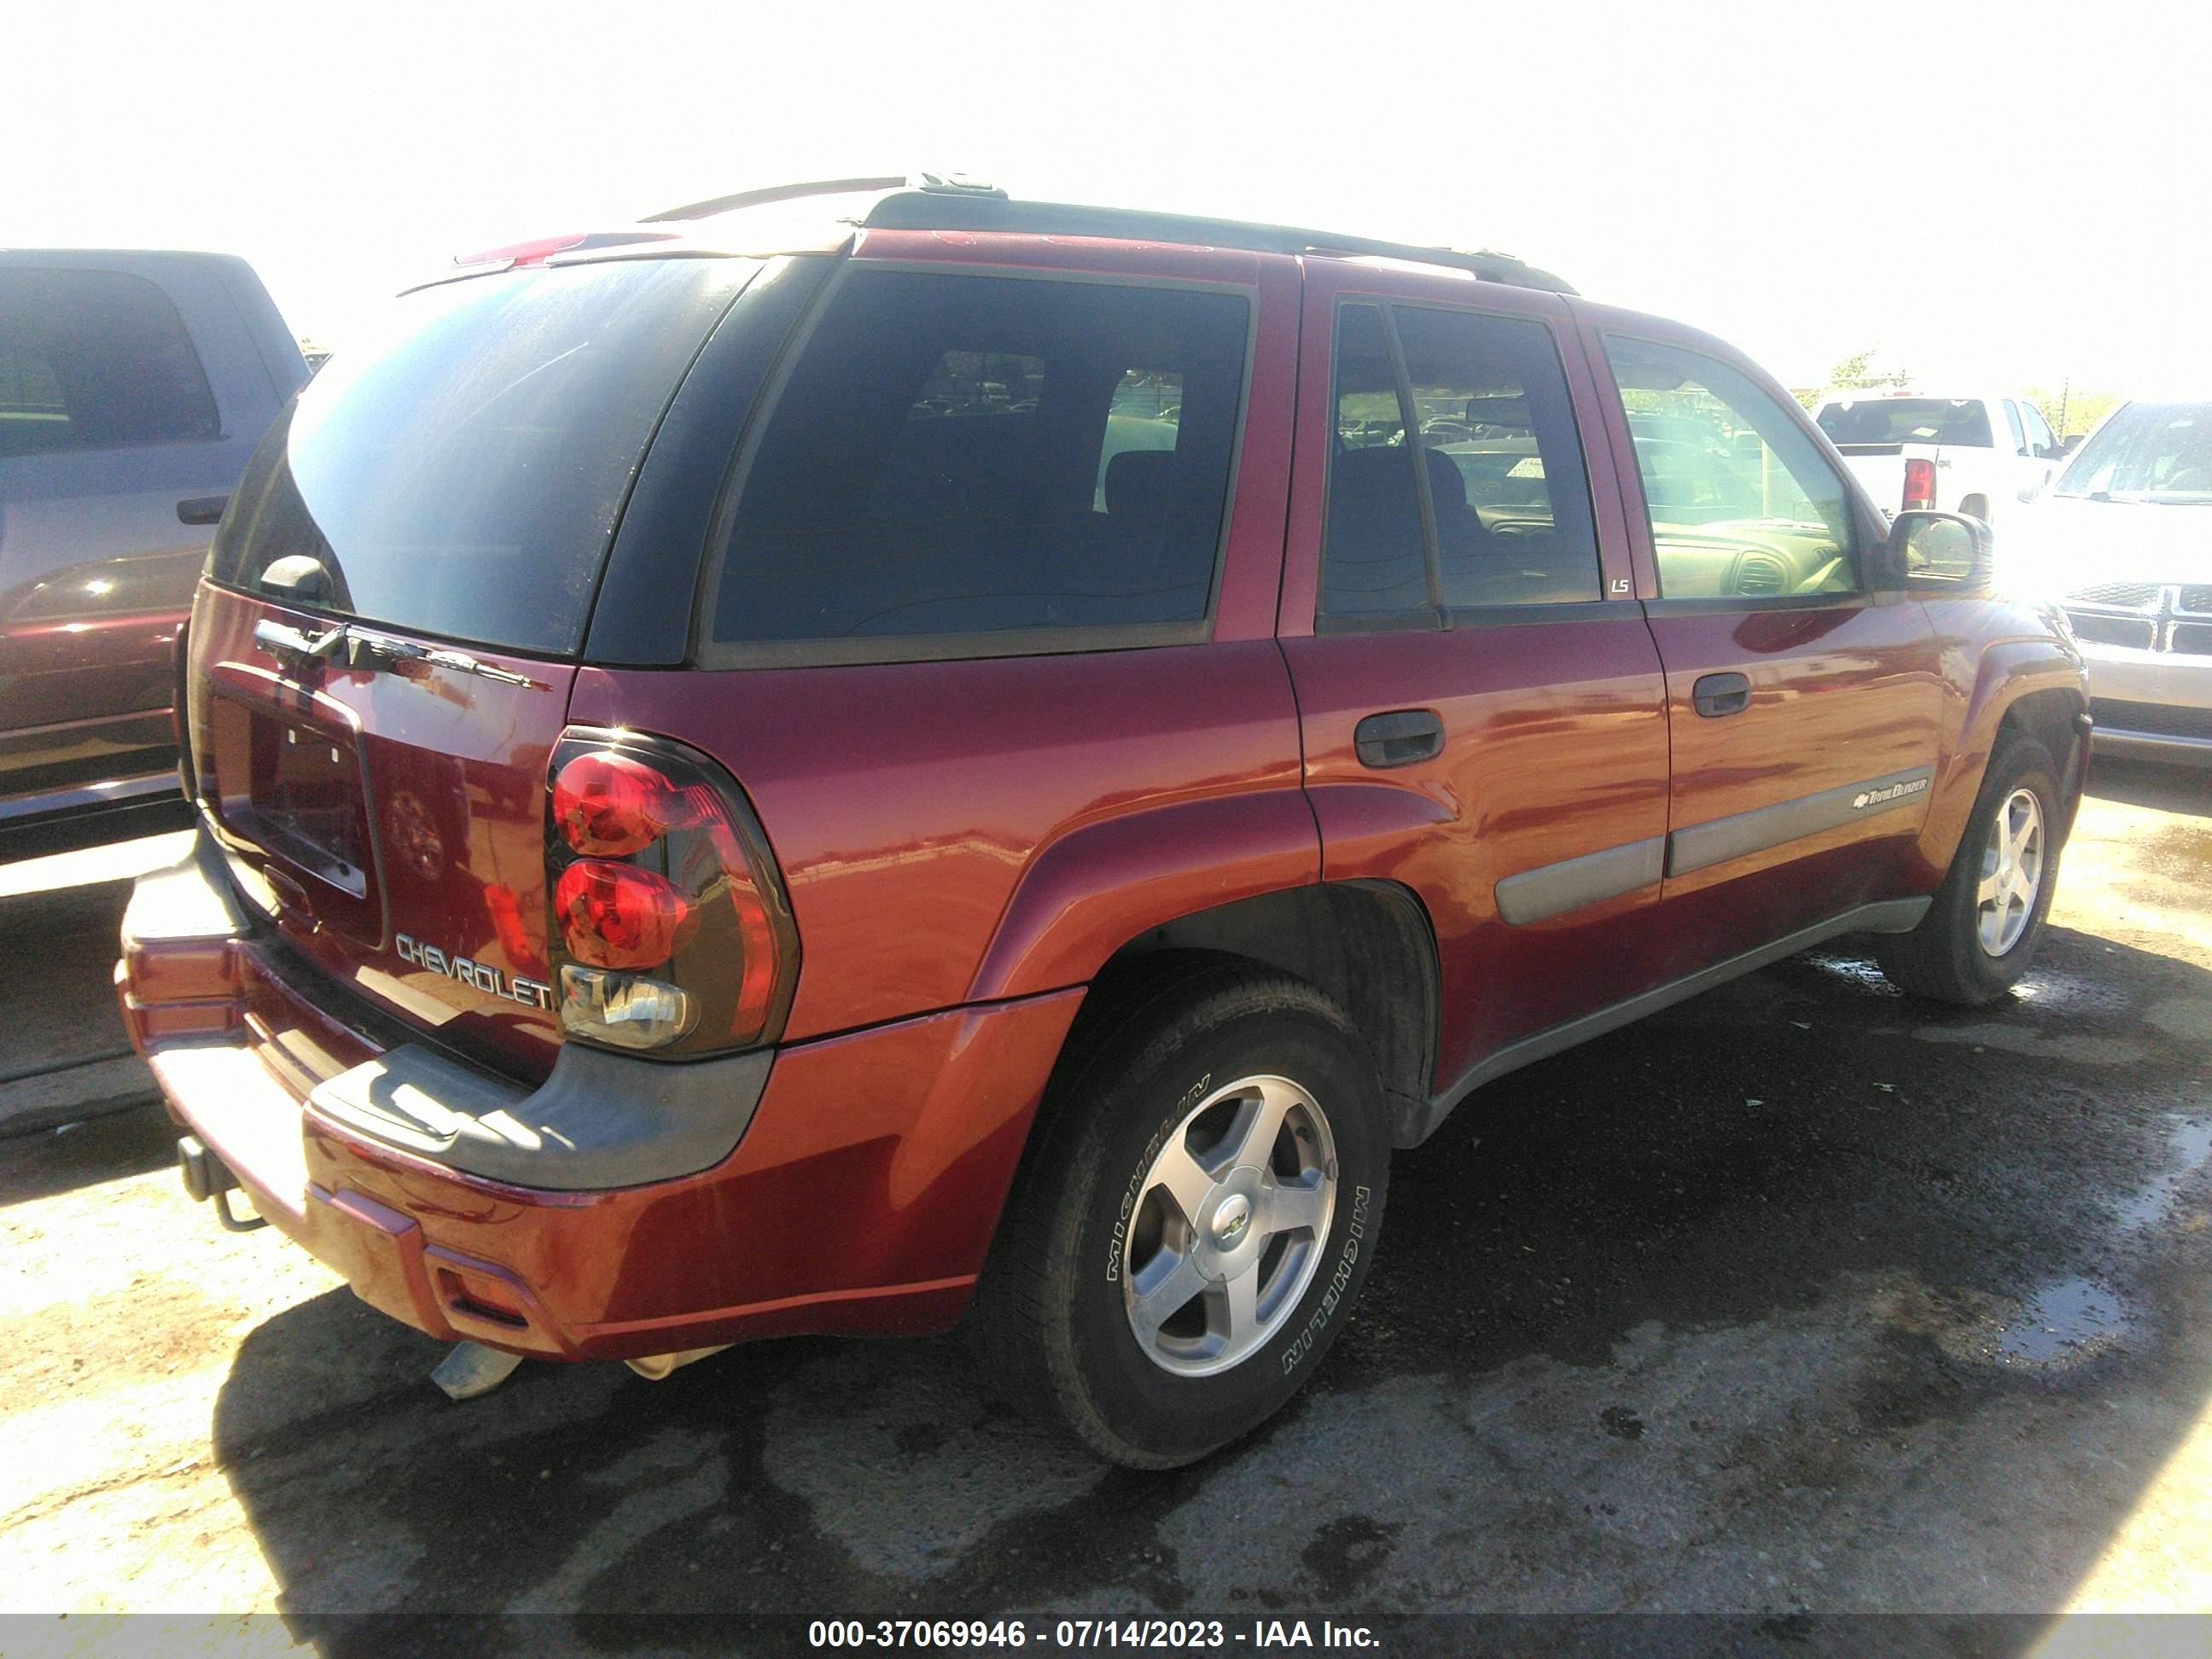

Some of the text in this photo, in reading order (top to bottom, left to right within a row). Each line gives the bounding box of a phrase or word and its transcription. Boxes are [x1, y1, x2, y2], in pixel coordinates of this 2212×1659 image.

[1610, 579, 1629, 593] LS
[395, 933, 552, 1011] CHEVROLET
[1106, 1073, 1212, 1282] MICHELIN
[1282, 1185, 1371, 1376] MICHELIN
